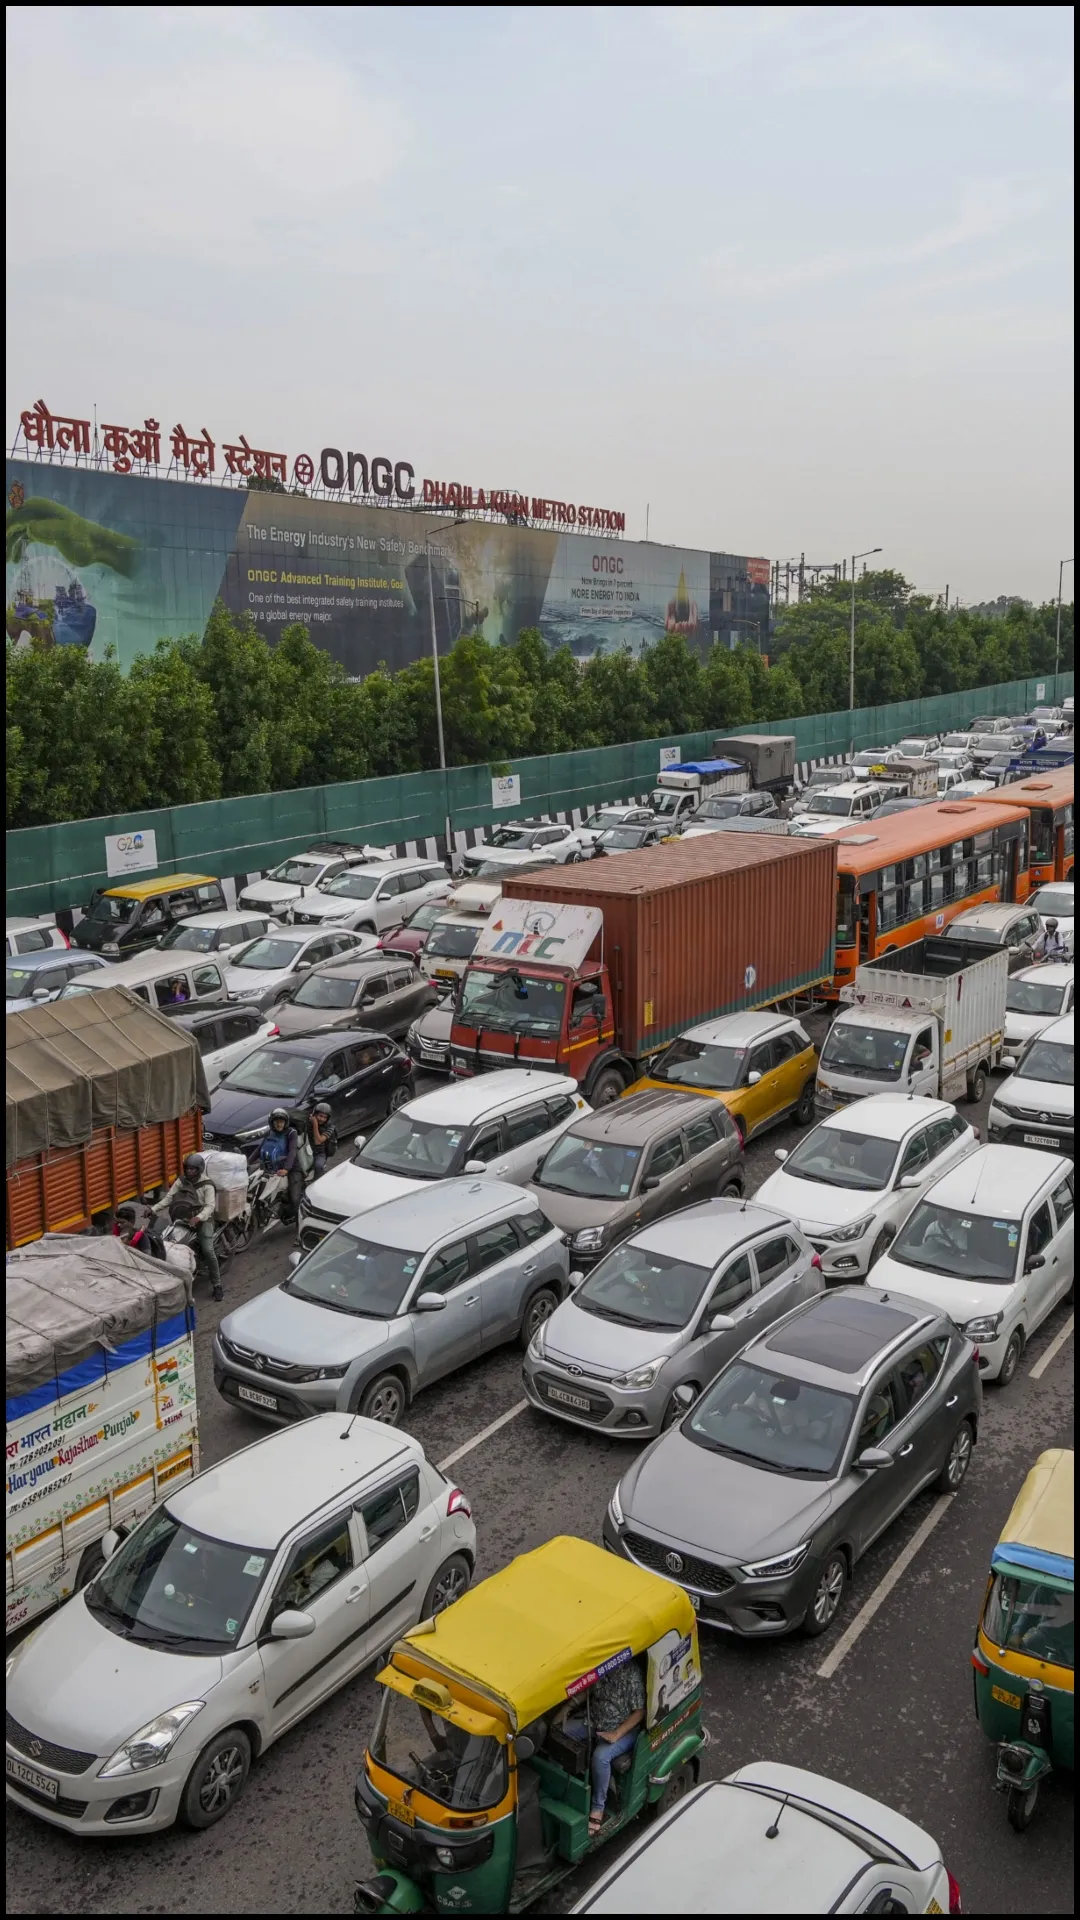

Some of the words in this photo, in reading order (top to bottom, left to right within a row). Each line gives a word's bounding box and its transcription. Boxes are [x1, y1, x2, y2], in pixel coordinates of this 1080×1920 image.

[20, 398, 91, 453] धौला
[222, 435, 287, 482] स्टेशन
[321, 447, 415, 500] ONGC
[423, 479, 486, 511] DHAULA
[490, 491, 529, 518] KUAN
[532, 498, 576, 524] METRO
[579, 505, 625, 532] STATION
[247, 525, 267, 540] The
[270, 526, 305, 547] Energy
[308, 530, 354, 550] Industry's
[357, 536, 376, 550] New
[380, 538, 406, 555] Safety
[248, 569, 277, 582] ONGC
[281, 573, 322, 585] Advanced
[324, 574, 356, 589] Training
[357, 577, 390, 590] Institute,
[592, 555, 624, 574] ONGC
[249, 592, 264, 603] One
[265, 592, 273, 604] of
[274, 593, 285, 604] the
[287, 594, 301, 605] best
[302, 594, 335, 608] integrated
[336, 596, 354, 609] safety
[571, 588, 589, 599] MORE
[591, 590, 615, 601] ENERGY
[615, 591, 624, 601] TO
[625, 592, 640, 601] INDIA
[249, 610, 259, 621] by
[266, 610, 287, 622] global
[289, 612, 312, 623] energy
[20, 1423, 51, 1449] भारत
[52, 1404, 87, 1432] महान
[7, 1458, 56, 1495] Haryana
[57, 1433, 99, 1466] Rajasthan
[103, 1412, 137, 1441] Punjab
